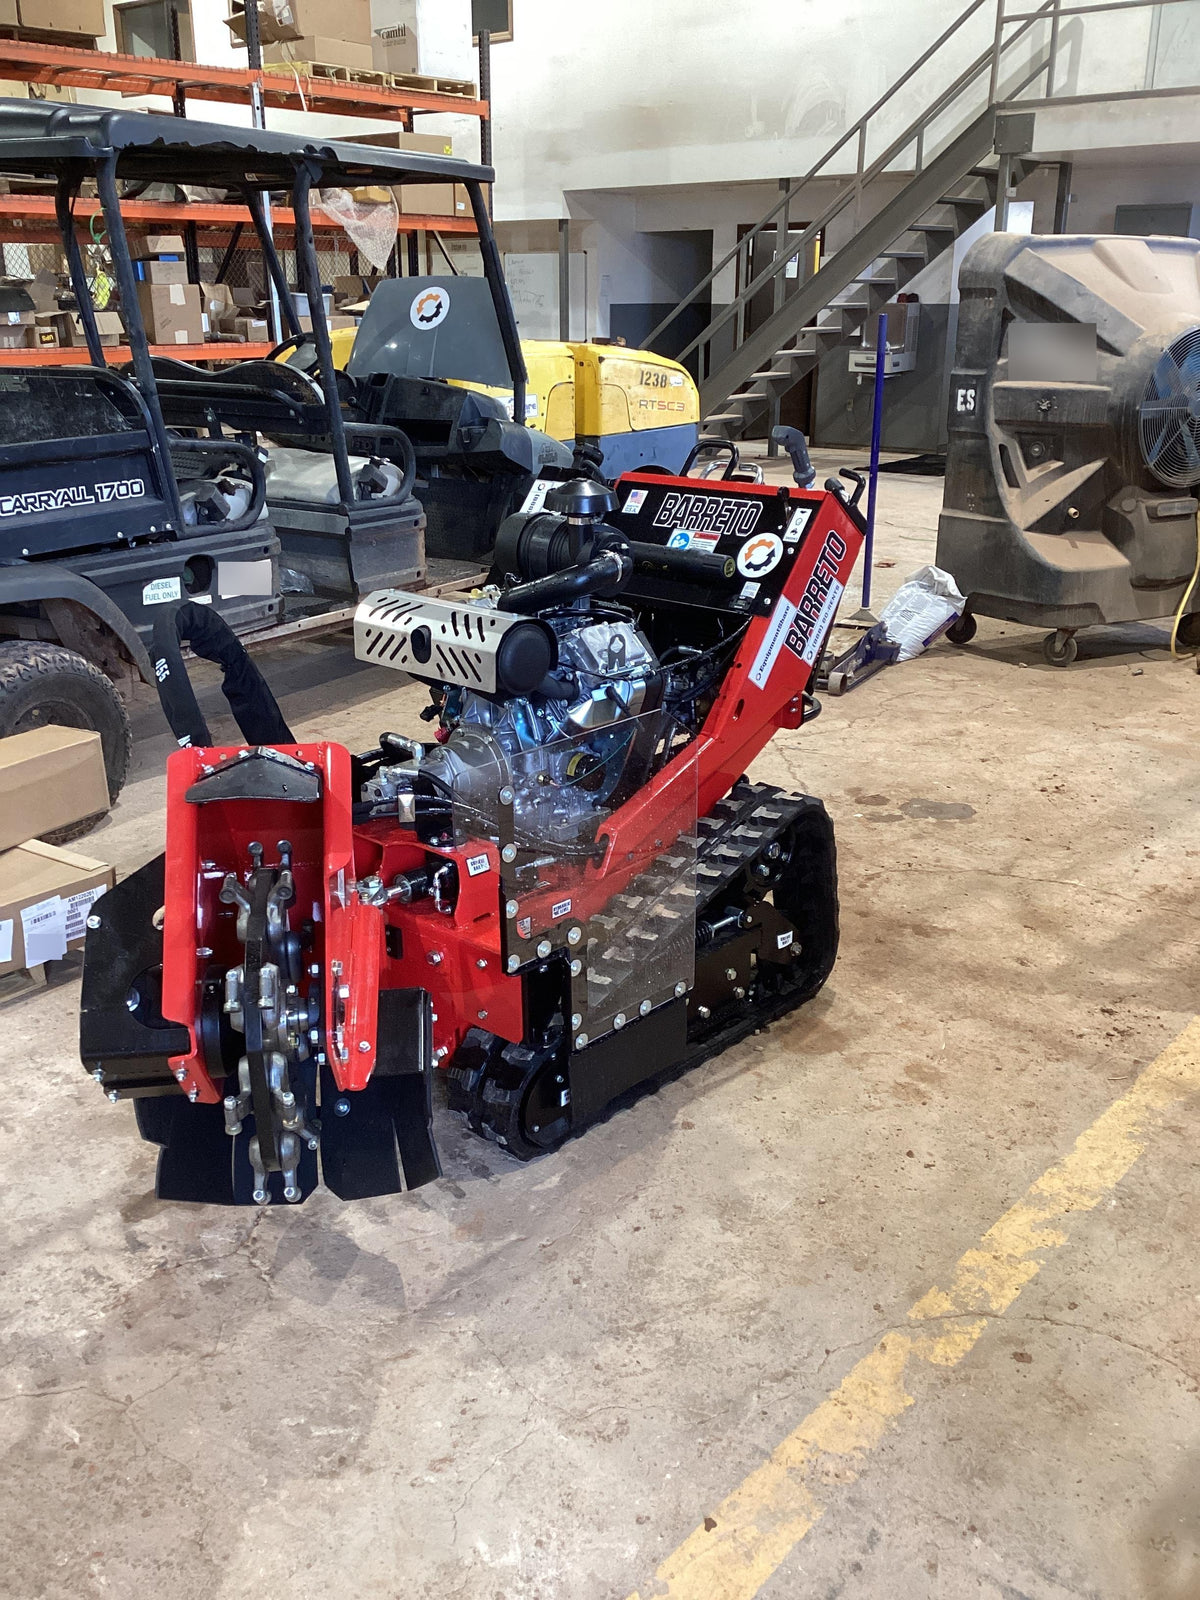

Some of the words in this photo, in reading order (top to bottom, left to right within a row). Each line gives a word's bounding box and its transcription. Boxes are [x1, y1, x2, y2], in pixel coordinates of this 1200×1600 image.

[41, 334, 54, 342] UPS
[639, 370, 668, 388] 1238
[639, 399, 685, 412] RTSC3
[956, 389, 976, 412] ES
[0, 486, 95, 516] CARRYALL
[95, 479, 145, 502] 1700
[653, 492, 764, 537] BARRETO
[145, 592, 161, 602] FUEL
[162, 589, 179, 600] ONLY
[150, 581, 173, 591] DIESEL
[783, 529, 847, 660] BARRETO
[760, 605, 790, 673] EquipmentShare
